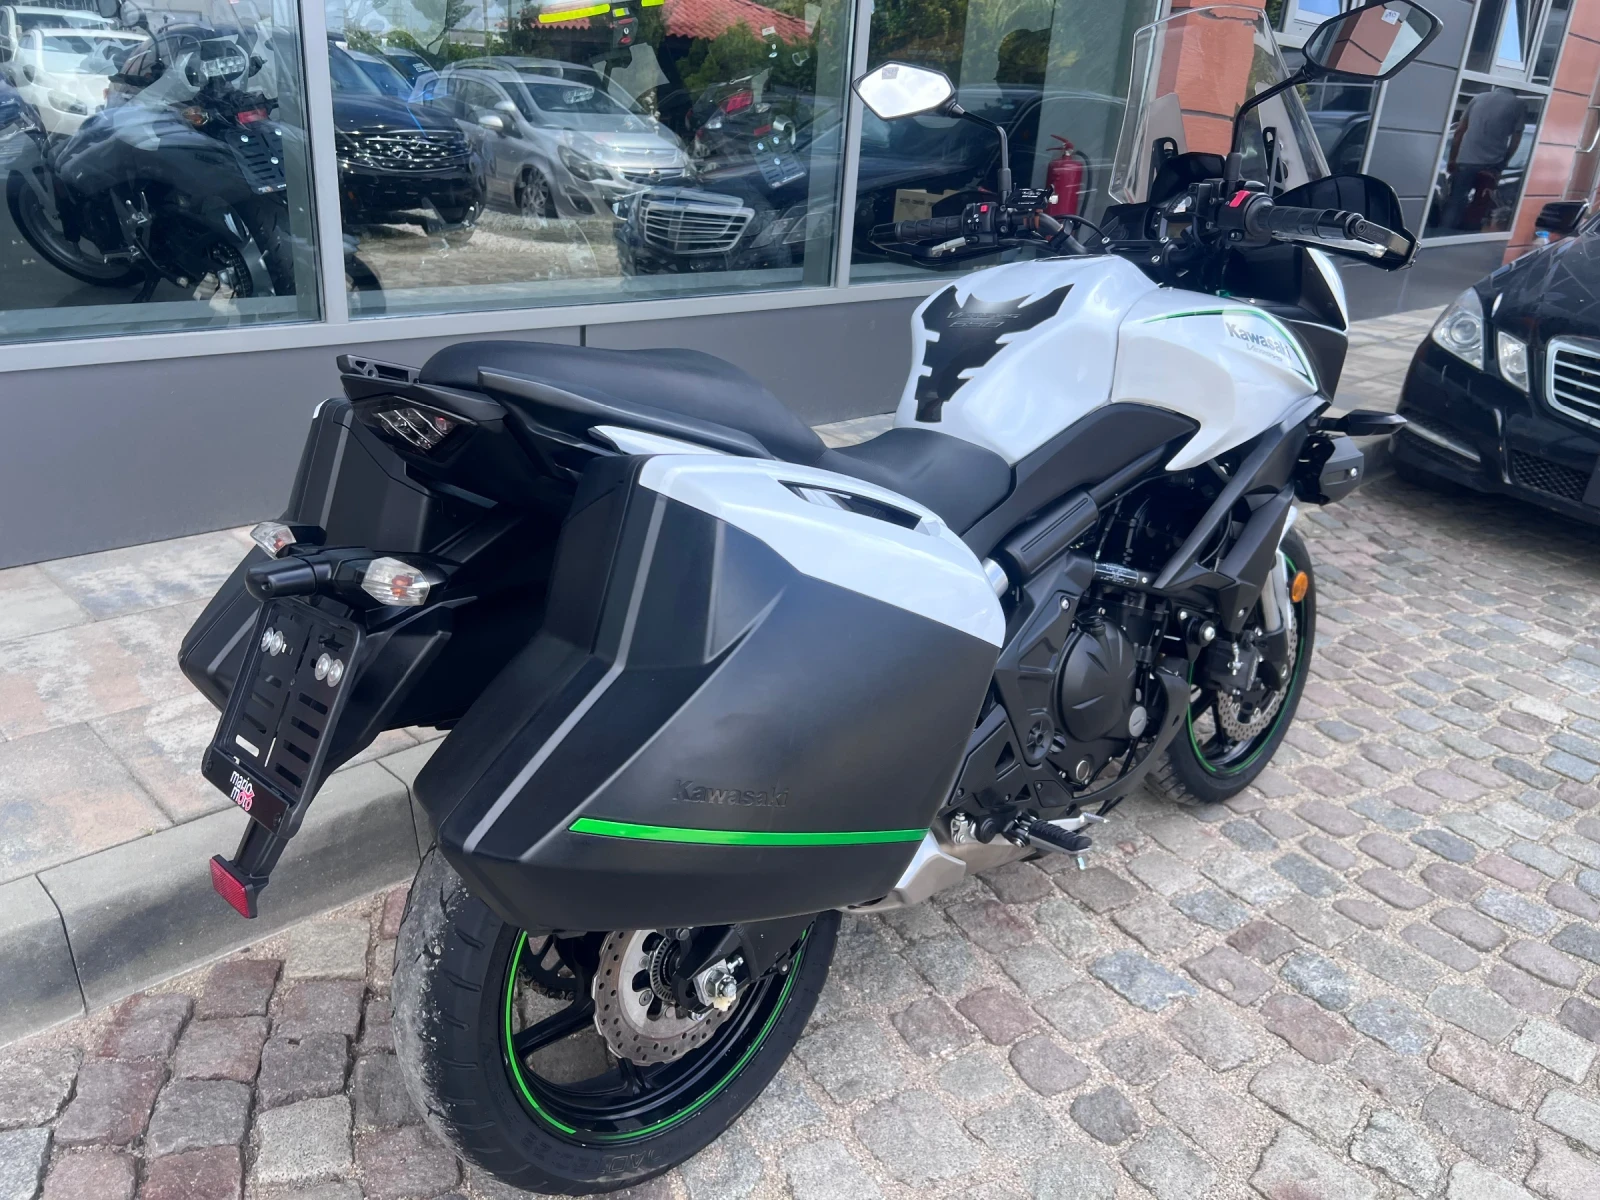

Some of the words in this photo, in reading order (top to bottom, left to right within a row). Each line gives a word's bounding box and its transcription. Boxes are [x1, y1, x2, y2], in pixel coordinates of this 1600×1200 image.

[948, 320, 1005, 328] 650
[230, 770, 253, 794] mario
[672, 779, 789, 808] Kawasaki
[230, 786, 253, 811] moto
